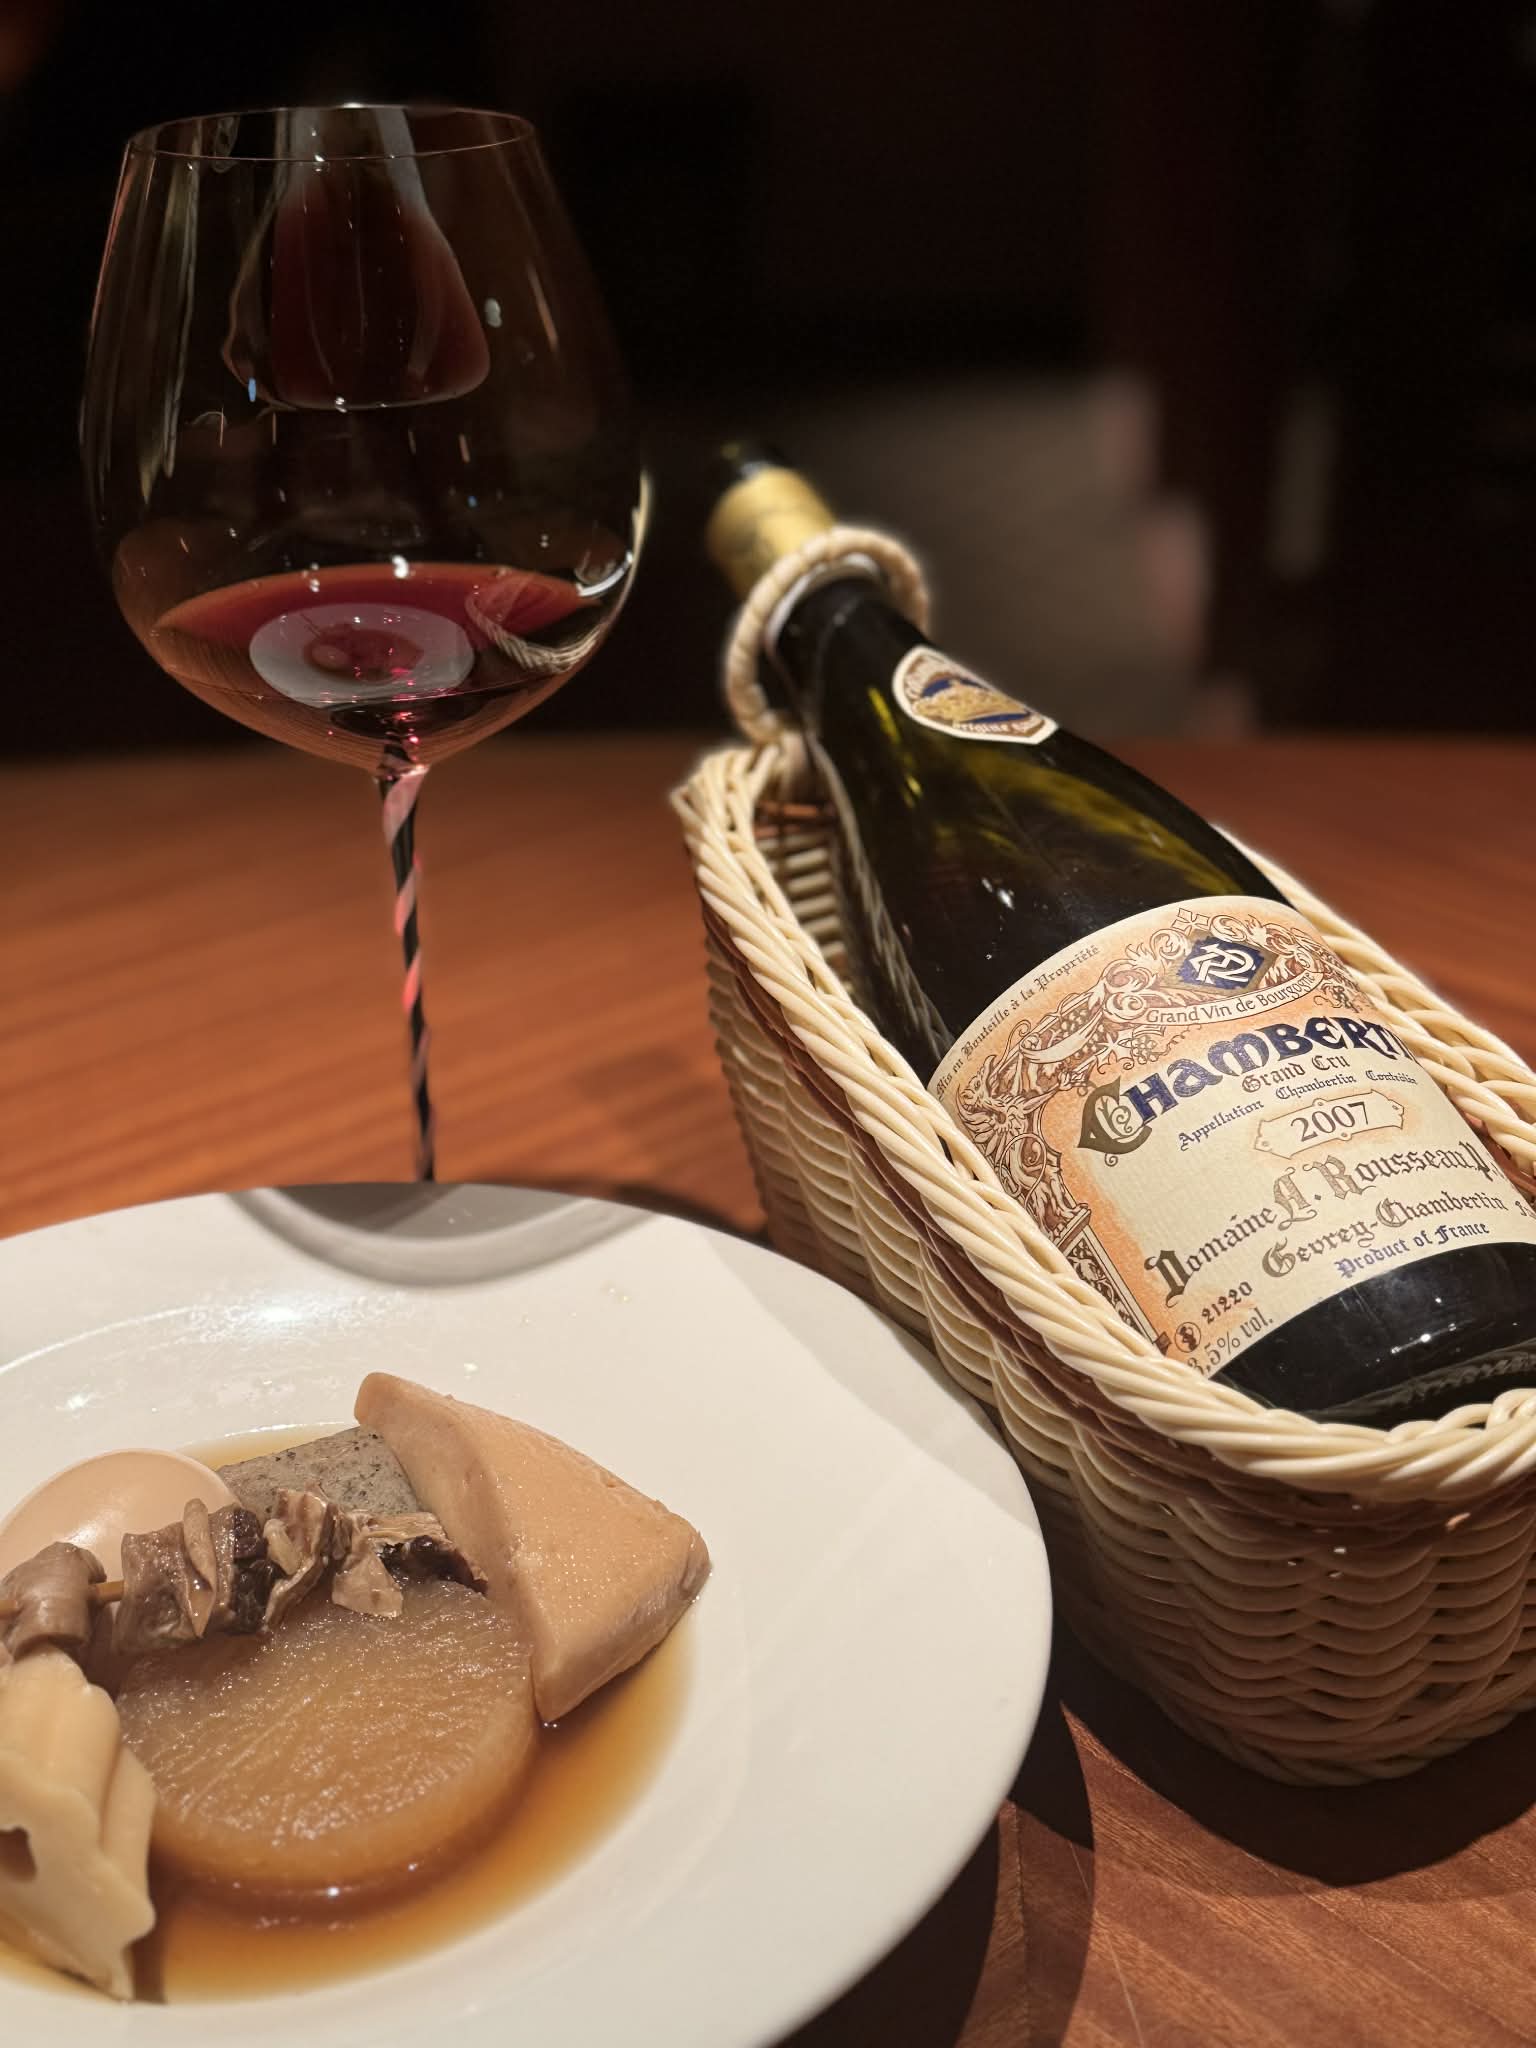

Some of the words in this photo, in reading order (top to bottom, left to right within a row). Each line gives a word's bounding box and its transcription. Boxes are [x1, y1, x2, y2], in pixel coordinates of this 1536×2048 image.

[961, 1008, 1010, 1060] Bouteille
[1020, 989, 1035, 1001] la
[1034, 945, 1101, 992] Propriété
[1146, 1007, 1200, 1024] Grand
[1201, 1003, 1231, 1020] Vin
[1236, 998, 1256, 1013] de
[1256, 972, 1316, 1007] Bourgogne
[1077, 1015, 1419, 1167] CHAMBERTI
[1241, 1062, 1306, 1093] Grand
[1311, 1055, 1350, 1071] Cru
[1178, 1100, 1265, 1151] Appellation
[1275, 1073, 1357, 1100] Chambertin
[1290, 1101, 1369, 1142] 2007
[1143, 1207, 1277, 1309] Domaine
[1262, 1191, 1508, 1278] Gevrey-Chambertin
[1334, 1239, 1411, 1278] Product
[1415, 1230, 1433, 1247] of
[1434, 1222, 1490, 1245] France
[1202, 1281, 1253, 1324] 21220
[1240, 1307, 1274, 1338] vol.
